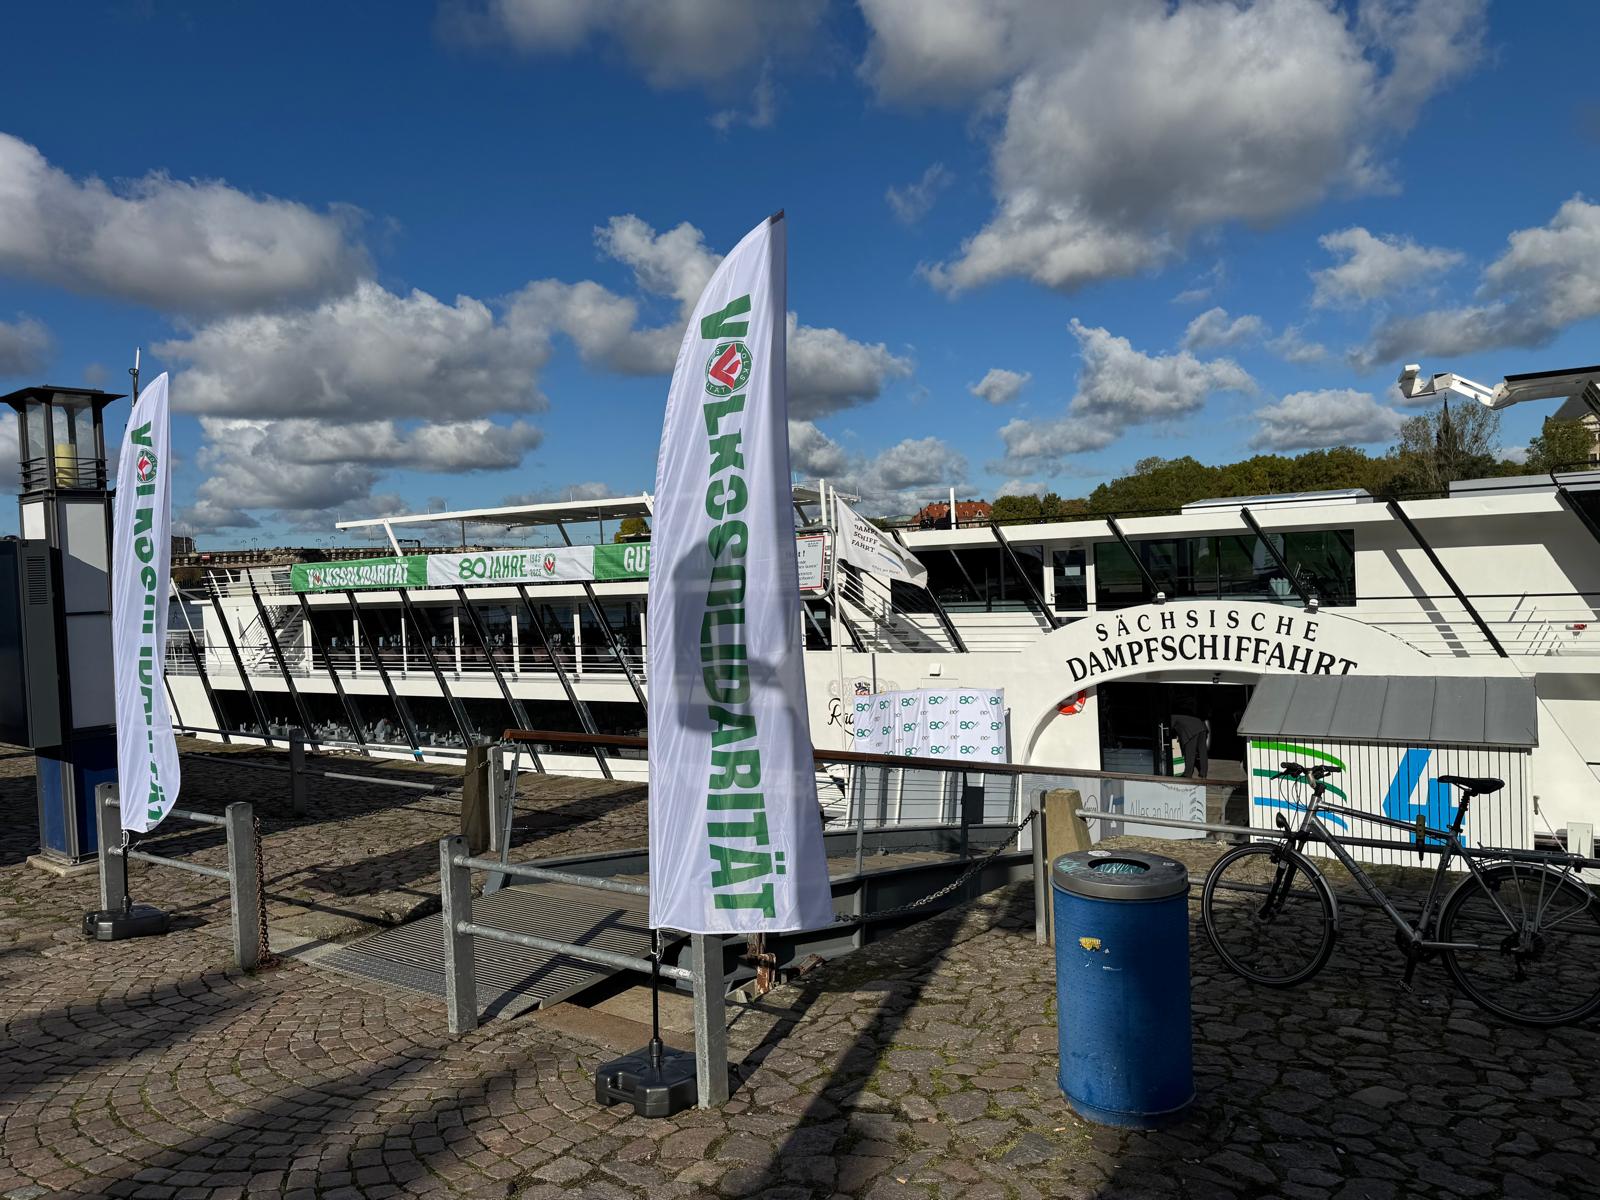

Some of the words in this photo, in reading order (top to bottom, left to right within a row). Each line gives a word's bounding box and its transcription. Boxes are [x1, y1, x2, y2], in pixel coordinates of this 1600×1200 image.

[851, 539, 876, 553] FAHRT
[853, 531, 879, 545] SCHIFF
[306, 558, 409, 589] VOLKSSOLIDARITÄT
[458, 557, 487, 579] 80
[488, 554, 528, 579] JAHRE
[700, 294, 786, 919] VOLKSSOLIDARITÄT
[1095, 609, 1319, 642] SÄCHSISCHE
[1065, 634, 1358, 682] DAMPFSCHIFFAHRT
[1381, 747, 1467, 849] 4
